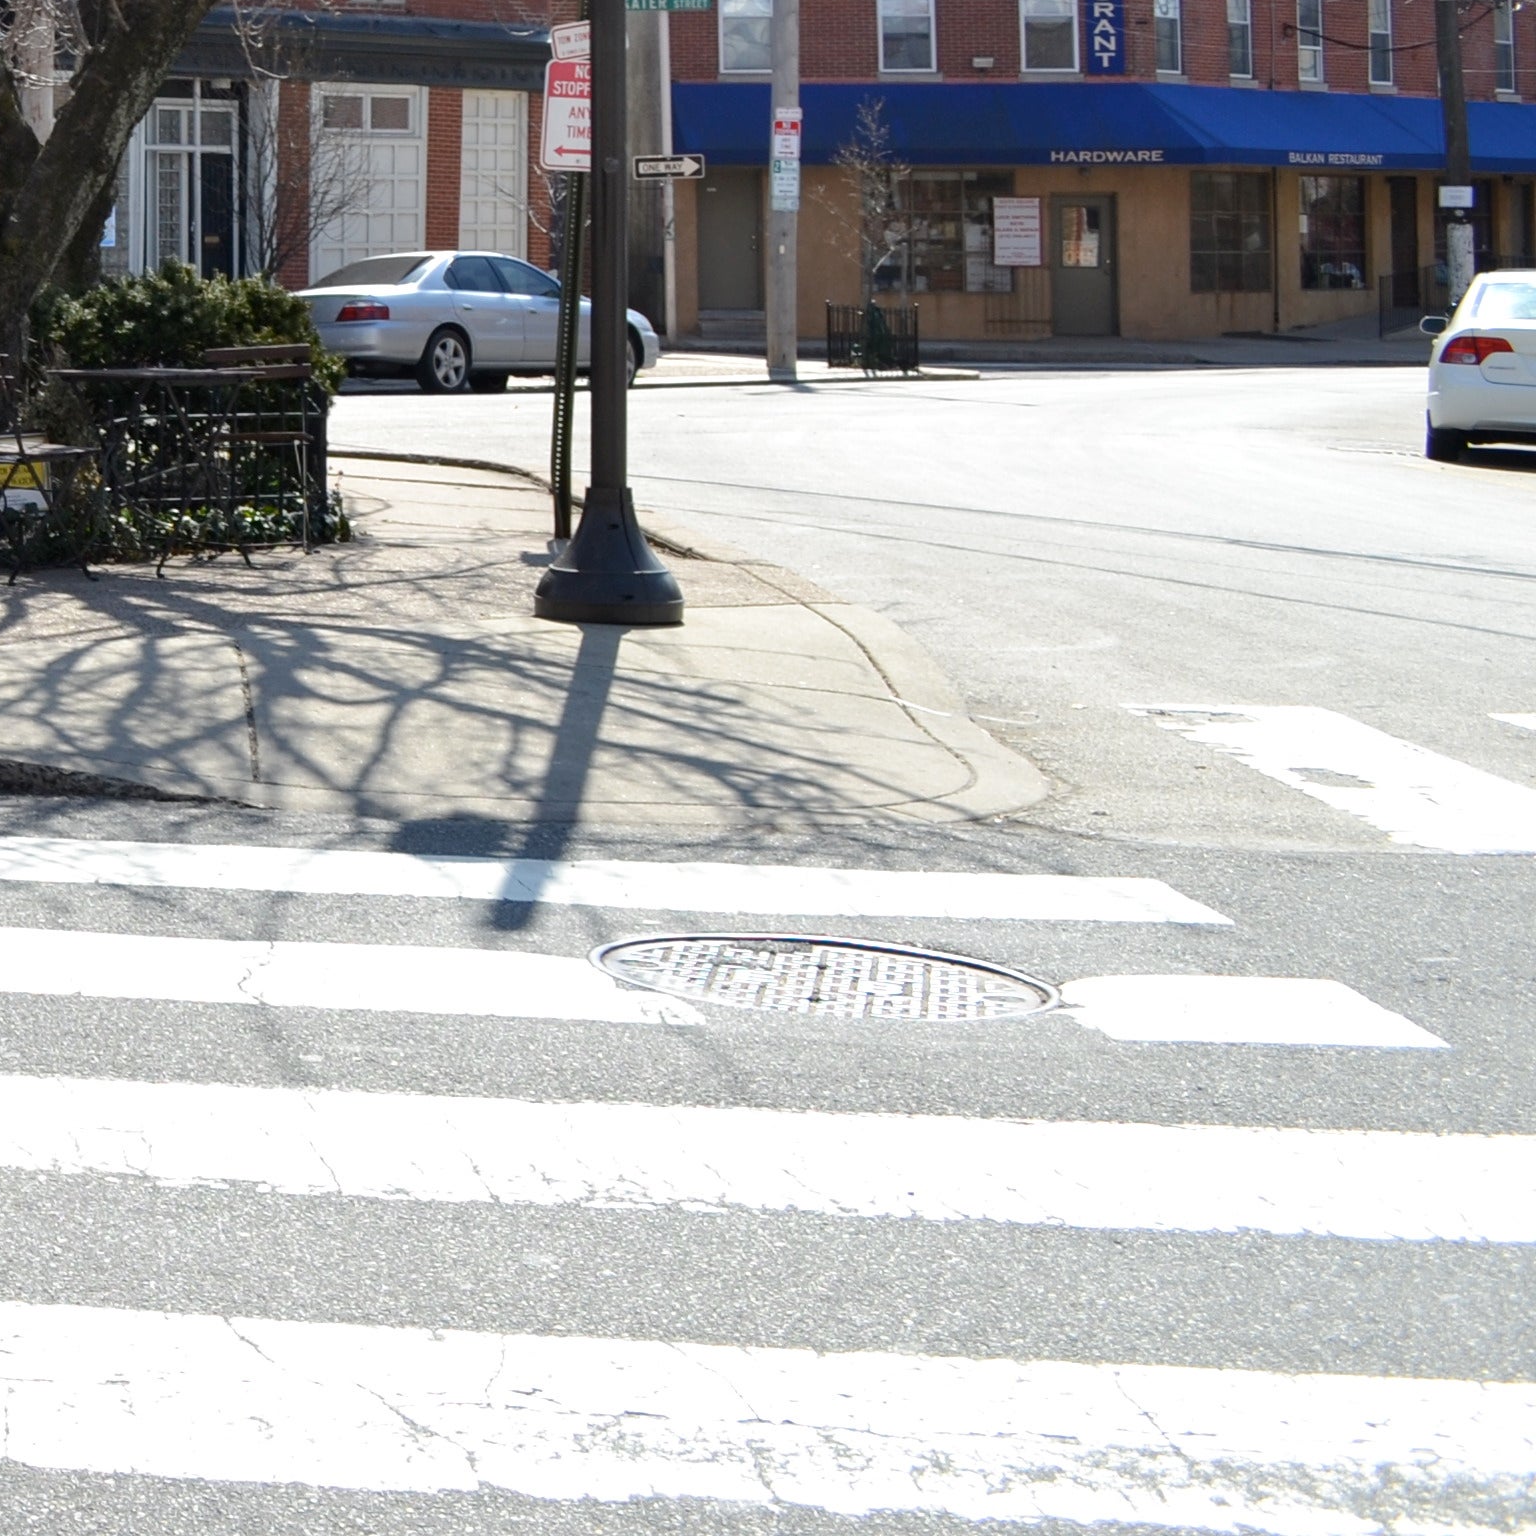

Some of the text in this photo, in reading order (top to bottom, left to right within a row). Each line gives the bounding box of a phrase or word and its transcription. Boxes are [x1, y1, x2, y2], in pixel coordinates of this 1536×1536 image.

[553, 80, 591, 96] STOPP
[1050, 150, 1165, 163] HARDWARE
[1288, 151, 1383, 165] BALKAN RESTAURANT
